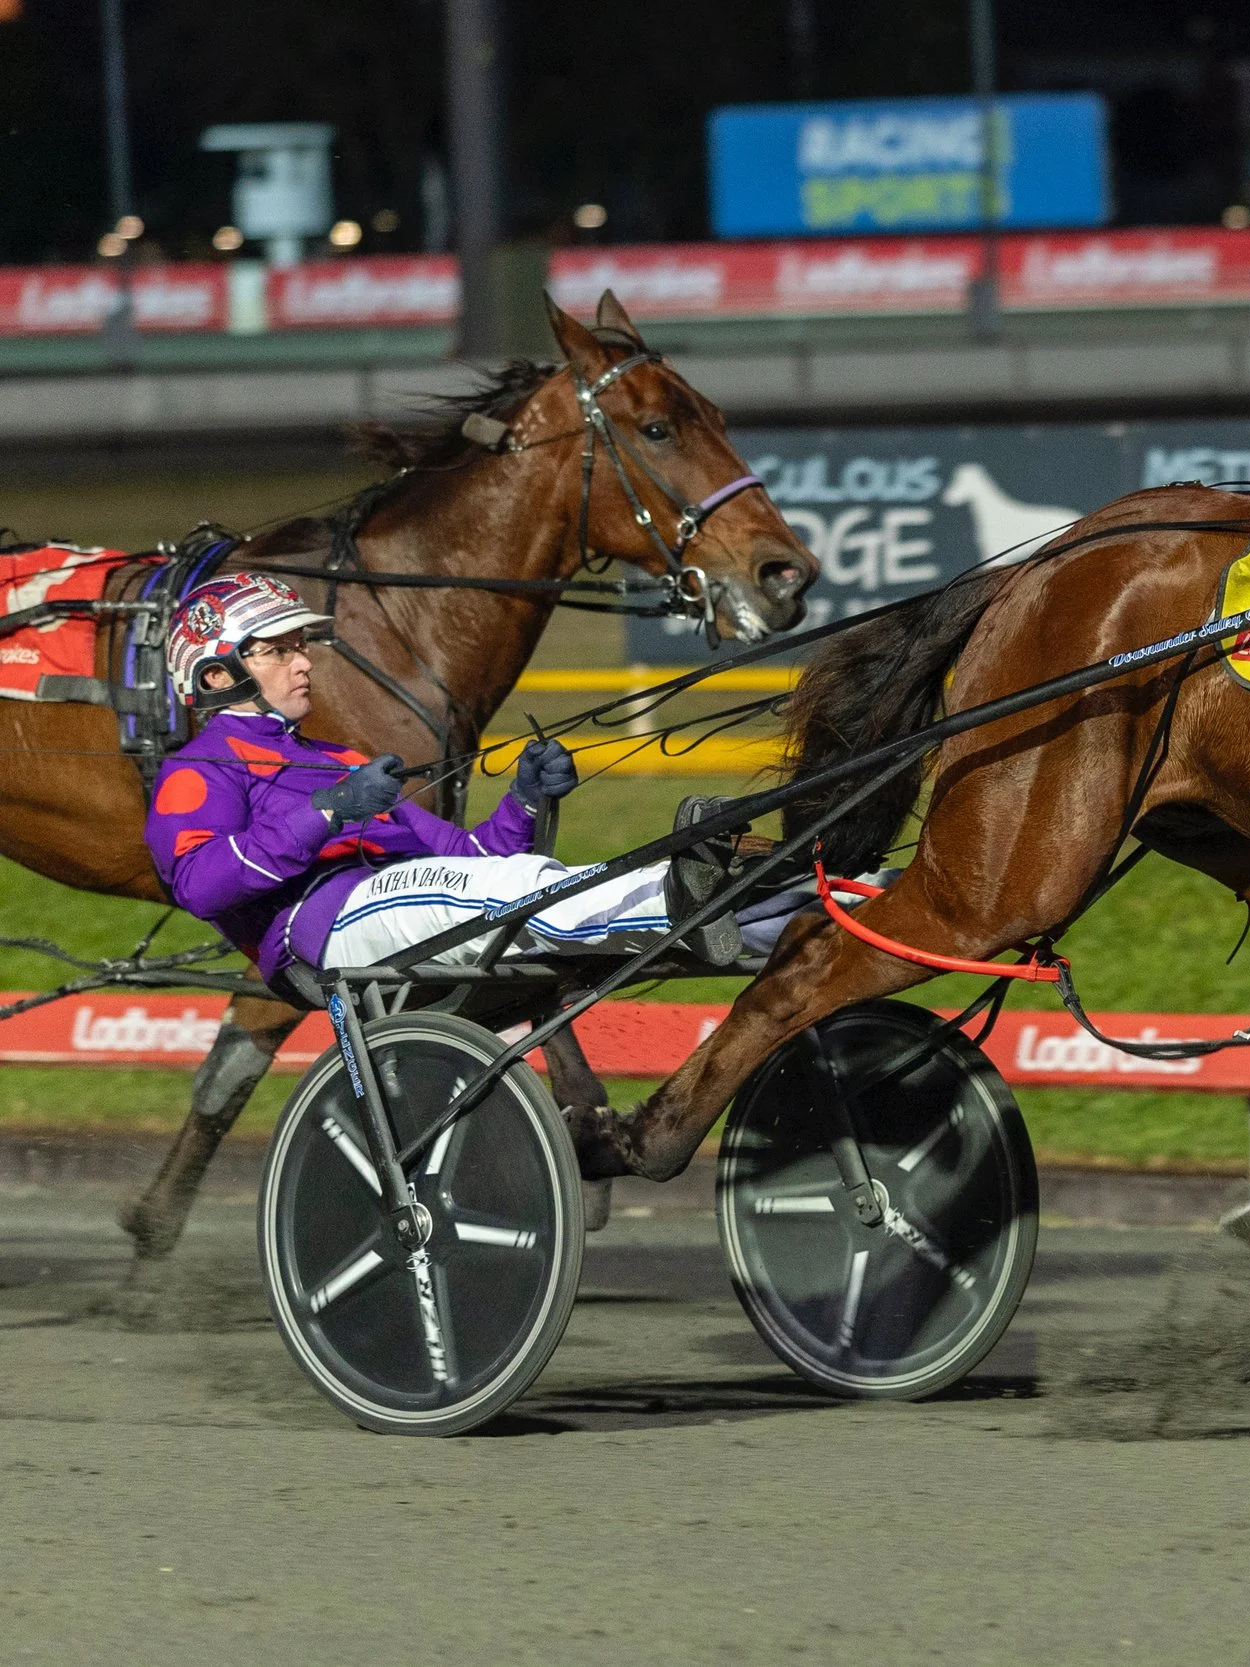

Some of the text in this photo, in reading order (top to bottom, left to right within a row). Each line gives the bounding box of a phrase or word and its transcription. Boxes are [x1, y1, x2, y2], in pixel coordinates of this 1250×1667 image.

[1108, 632, 1198, 668] Downunder
[1198, 613, 1243, 638] Sulky
[366, 867, 422, 899] NATHAN
[71, 1006, 223, 1051] Ladbroke
